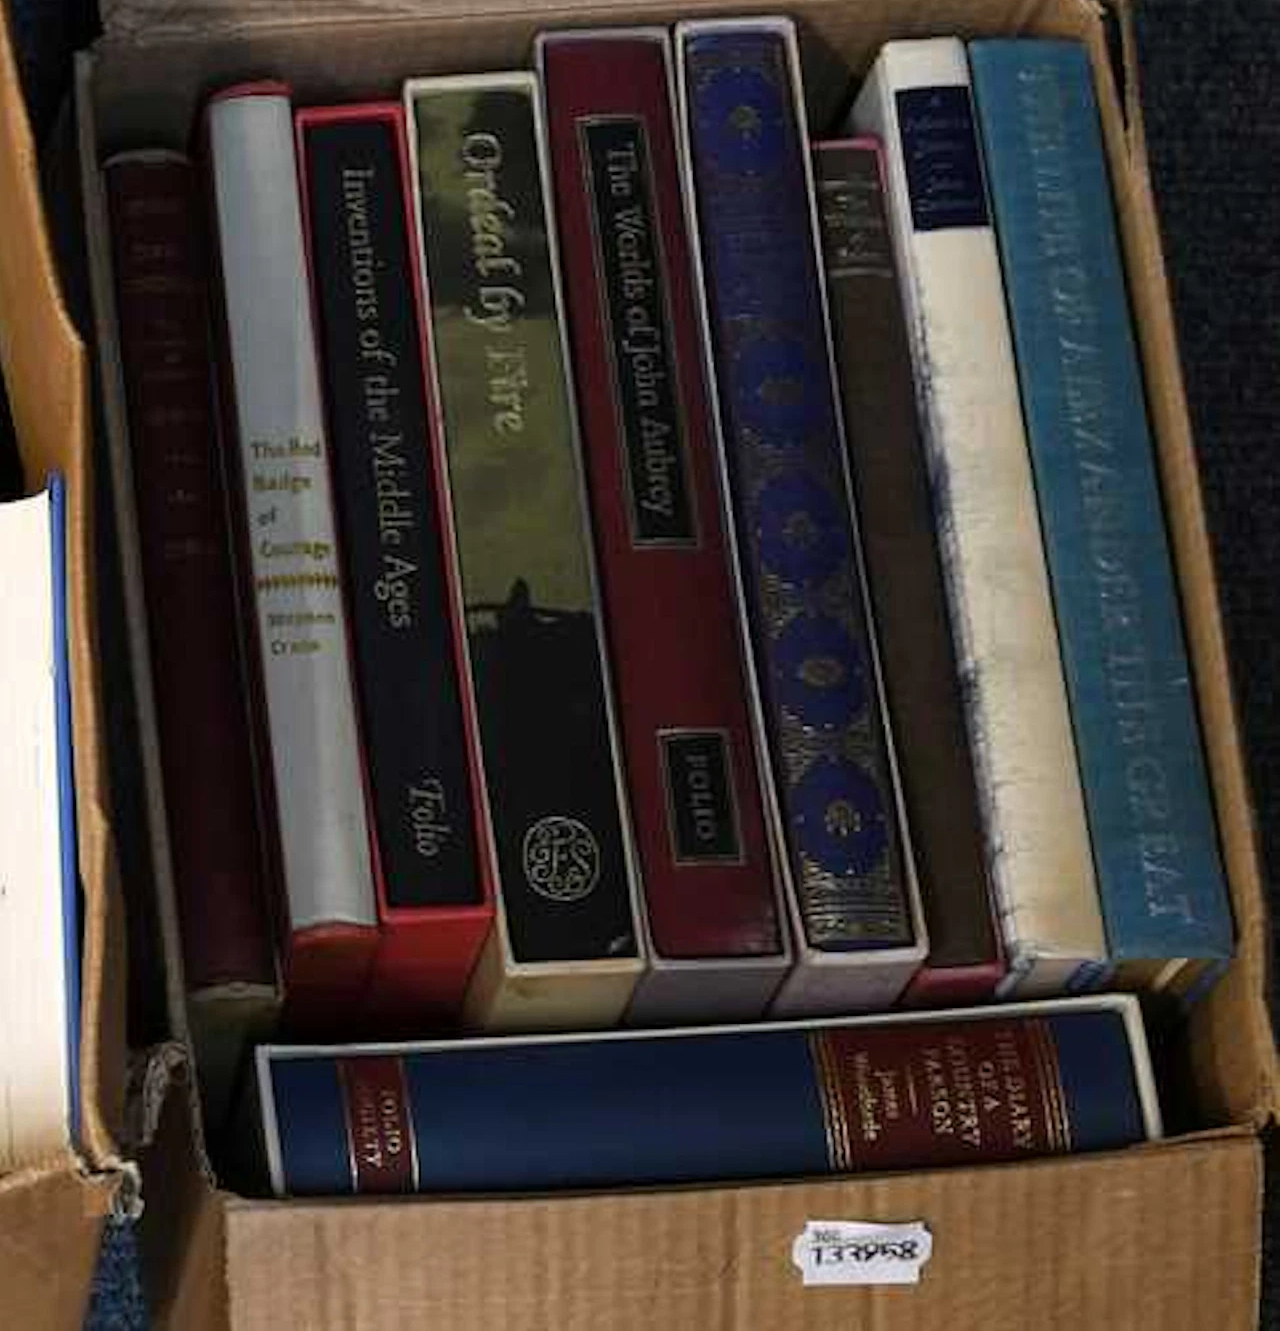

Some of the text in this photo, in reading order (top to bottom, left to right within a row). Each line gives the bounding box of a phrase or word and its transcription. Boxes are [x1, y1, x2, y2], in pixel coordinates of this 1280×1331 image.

[605, 139, 639, 198] The
[462, 129, 527, 432] Ordeal by Fire
[613, 205, 654, 303] Worlds
[341, 165, 423, 631] Inventions of the Middle Ages
[623, 339, 667, 409] John
[639, 418, 678, 518] Aubrey
[257, 506, 277, 527] of
[415, 779, 445, 860] Folio
[685, 754, 716, 841] FOLIO
[1123, 757, 1194, 929] GREAT
[1003, 1067, 1035, 1150] DIARY
